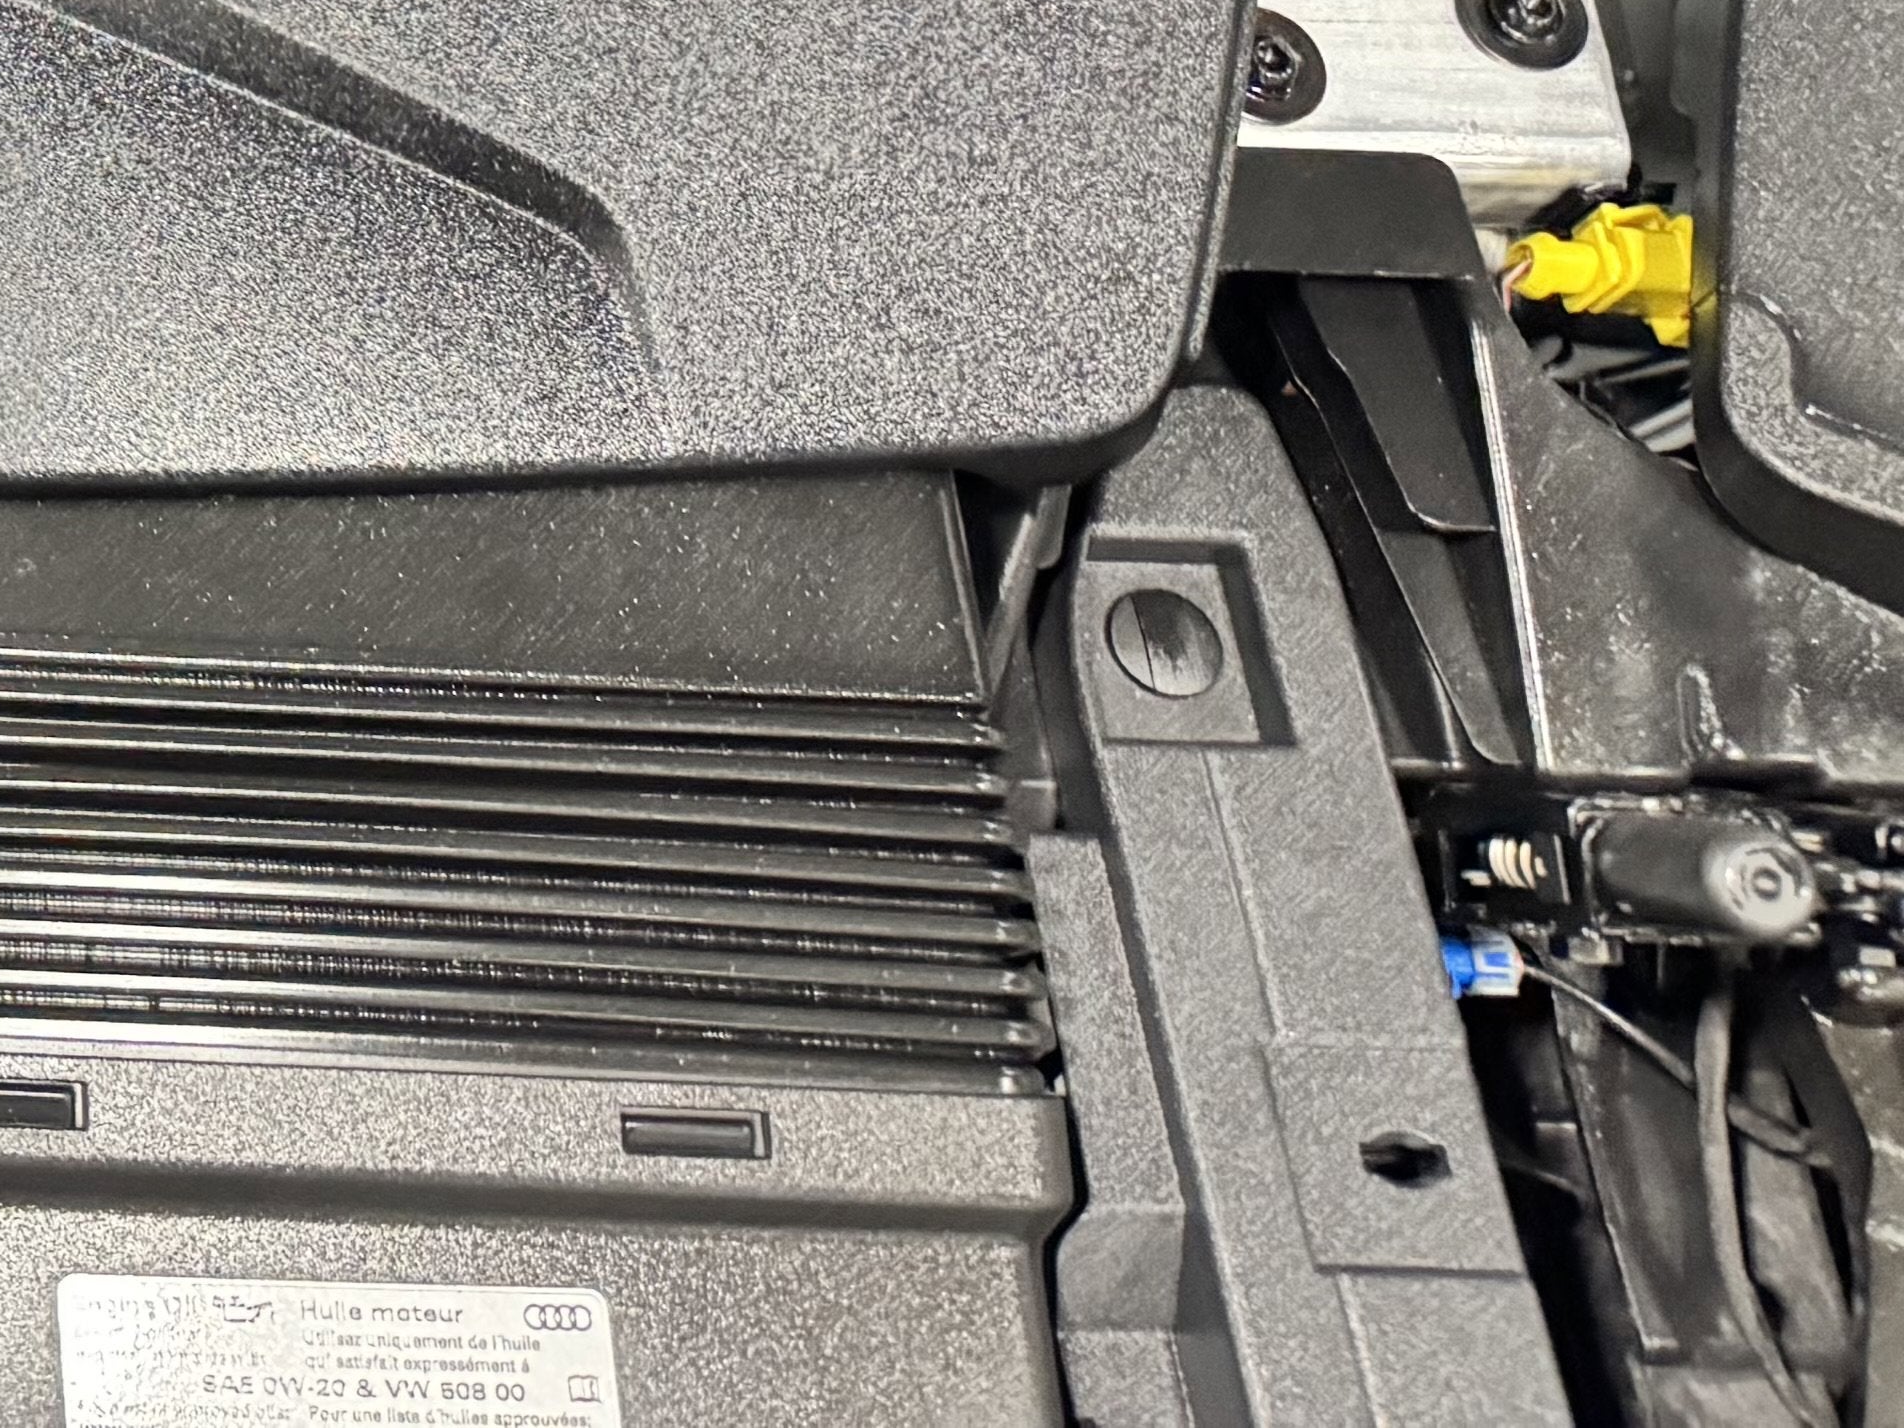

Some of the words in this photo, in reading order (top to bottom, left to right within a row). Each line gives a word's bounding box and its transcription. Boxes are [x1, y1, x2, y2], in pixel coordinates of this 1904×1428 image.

[300, 1299, 363, 1322] Huile
[371, 1304, 464, 1324] moteur
[366, 1332, 463, 1352] uniquement
[467, 1335, 488, 1351] de
[336, 1354, 399, 1373] satisfait
[202, 1374, 255, 1395] SAE
[262, 1376, 346, 1398] 0W-20
[356, 1378, 377, 1399] &
[385, 1379, 431, 1399] VW
[441, 1382, 487, 1401] 508
[495, 1382, 526, 1402] 00
[308, 1404, 347, 1422] Pour
[353, 1408, 382, 1424] une
[387, 1407, 420, 1425] liste
